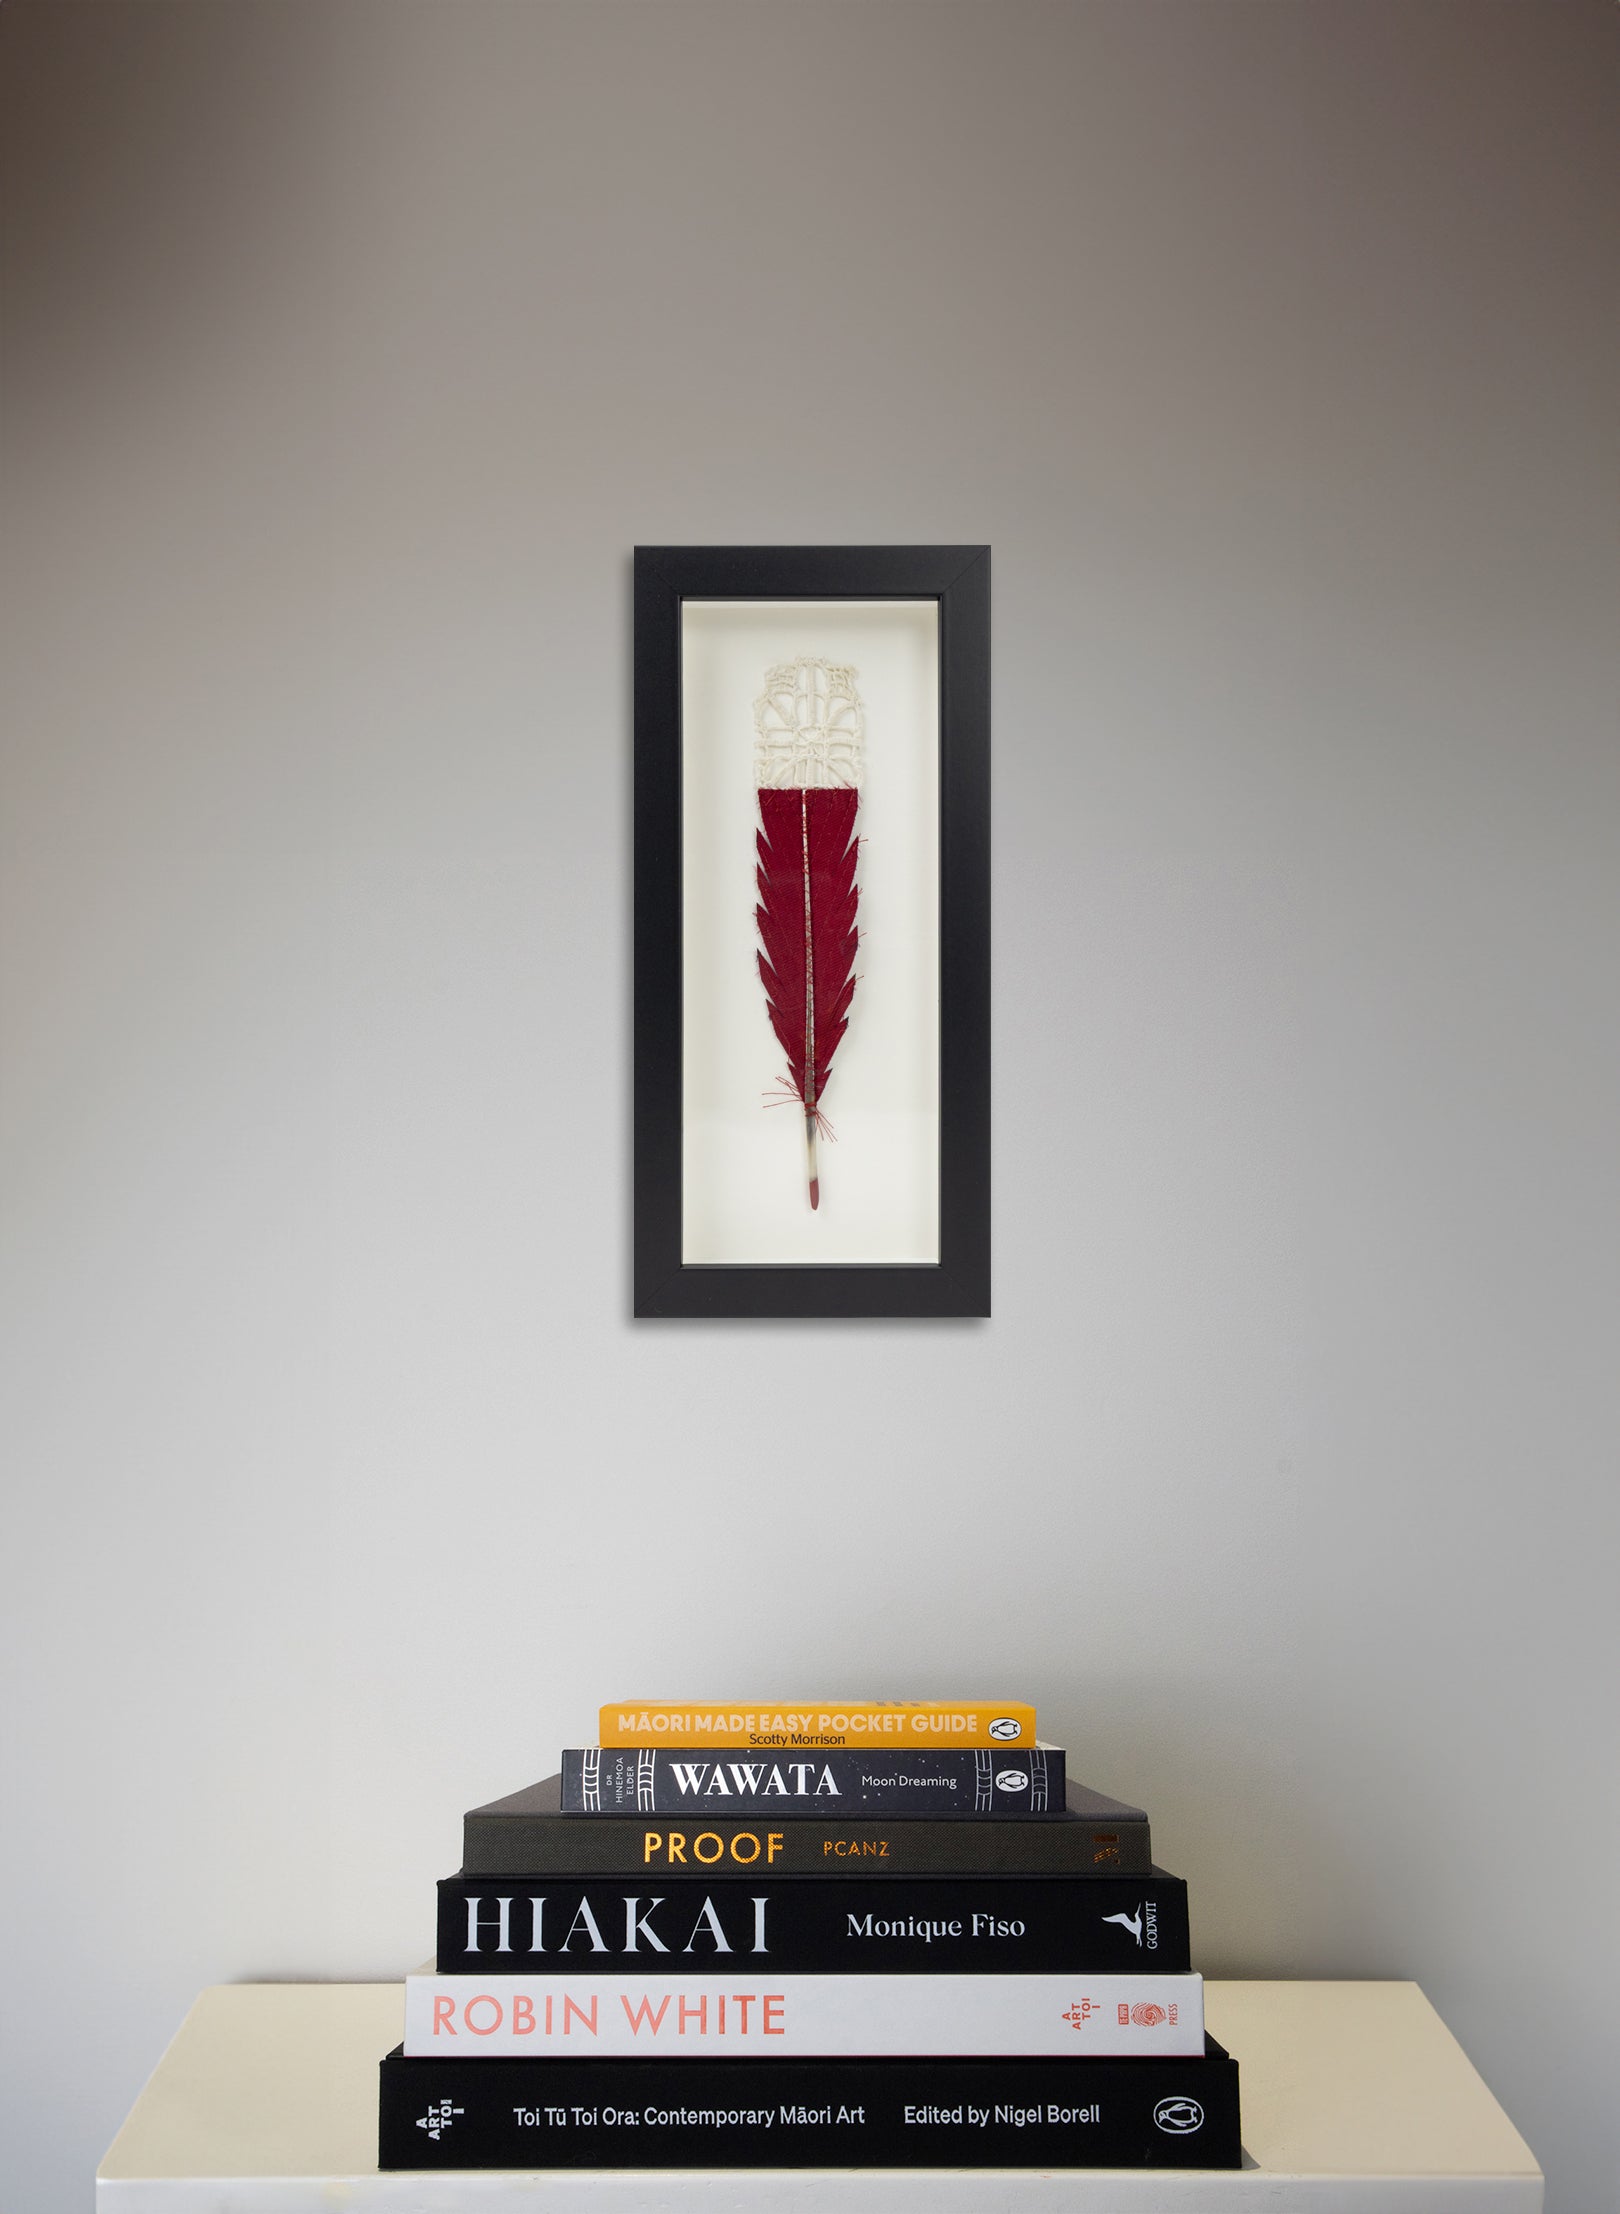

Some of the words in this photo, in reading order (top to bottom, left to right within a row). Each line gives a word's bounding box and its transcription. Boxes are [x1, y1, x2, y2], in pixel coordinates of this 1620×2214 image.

[618, 1712, 691, 1732] MĀORI
[695, 1714, 756, 1732] MADE
[760, 1714, 812, 1732] EASY
[819, 1714, 906, 1732] POCKET
[911, 1714, 977, 1732] GUIDE
[749, 1733, 789, 1749] Scotty
[791, 1732, 846, 1746] Morrison
[605, 1774, 613, 1786] DR
[616, 1757, 624, 1803] HINEMOA
[626, 1765, 635, 1795] ELDER
[669, 1763, 843, 1796] WAWATA
[861, 1774, 896, 1787] Moon
[899, 1774, 957, 1790] Dreaming
[644, 1832, 784, 1864] PROOF
[823, 1840, 890, 1857] PCANZ
[464, 1896, 771, 1953] HIAKAI
[847, 1913, 962, 1943] Monique
[971, 1913, 1026, 1938] Fiso
[1145, 1901, 1158, 1950] GODWIT
[433, 1994, 598, 2036] ROBIN
[620, 1994, 785, 2036] WHITE
[1168, 2003, 1178, 2026] PRESS
[513, 2107, 540, 2126] Toi
[543, 2107, 566, 2126] Tū
[571, 2107, 598, 2126] Toi
[602, 2107, 640, 2126] Ora:
[643, 2106, 776, 2129] Contemporary
[780, 2104, 832, 2125] Māori
[836, 2106, 865, 2124] Art
[904, 2105, 963, 2125] Edited
[967, 2105, 990, 2128] by
[994, 2104, 1042, 2128] Nigel
[1047, 2104, 1100, 2124] Borell
